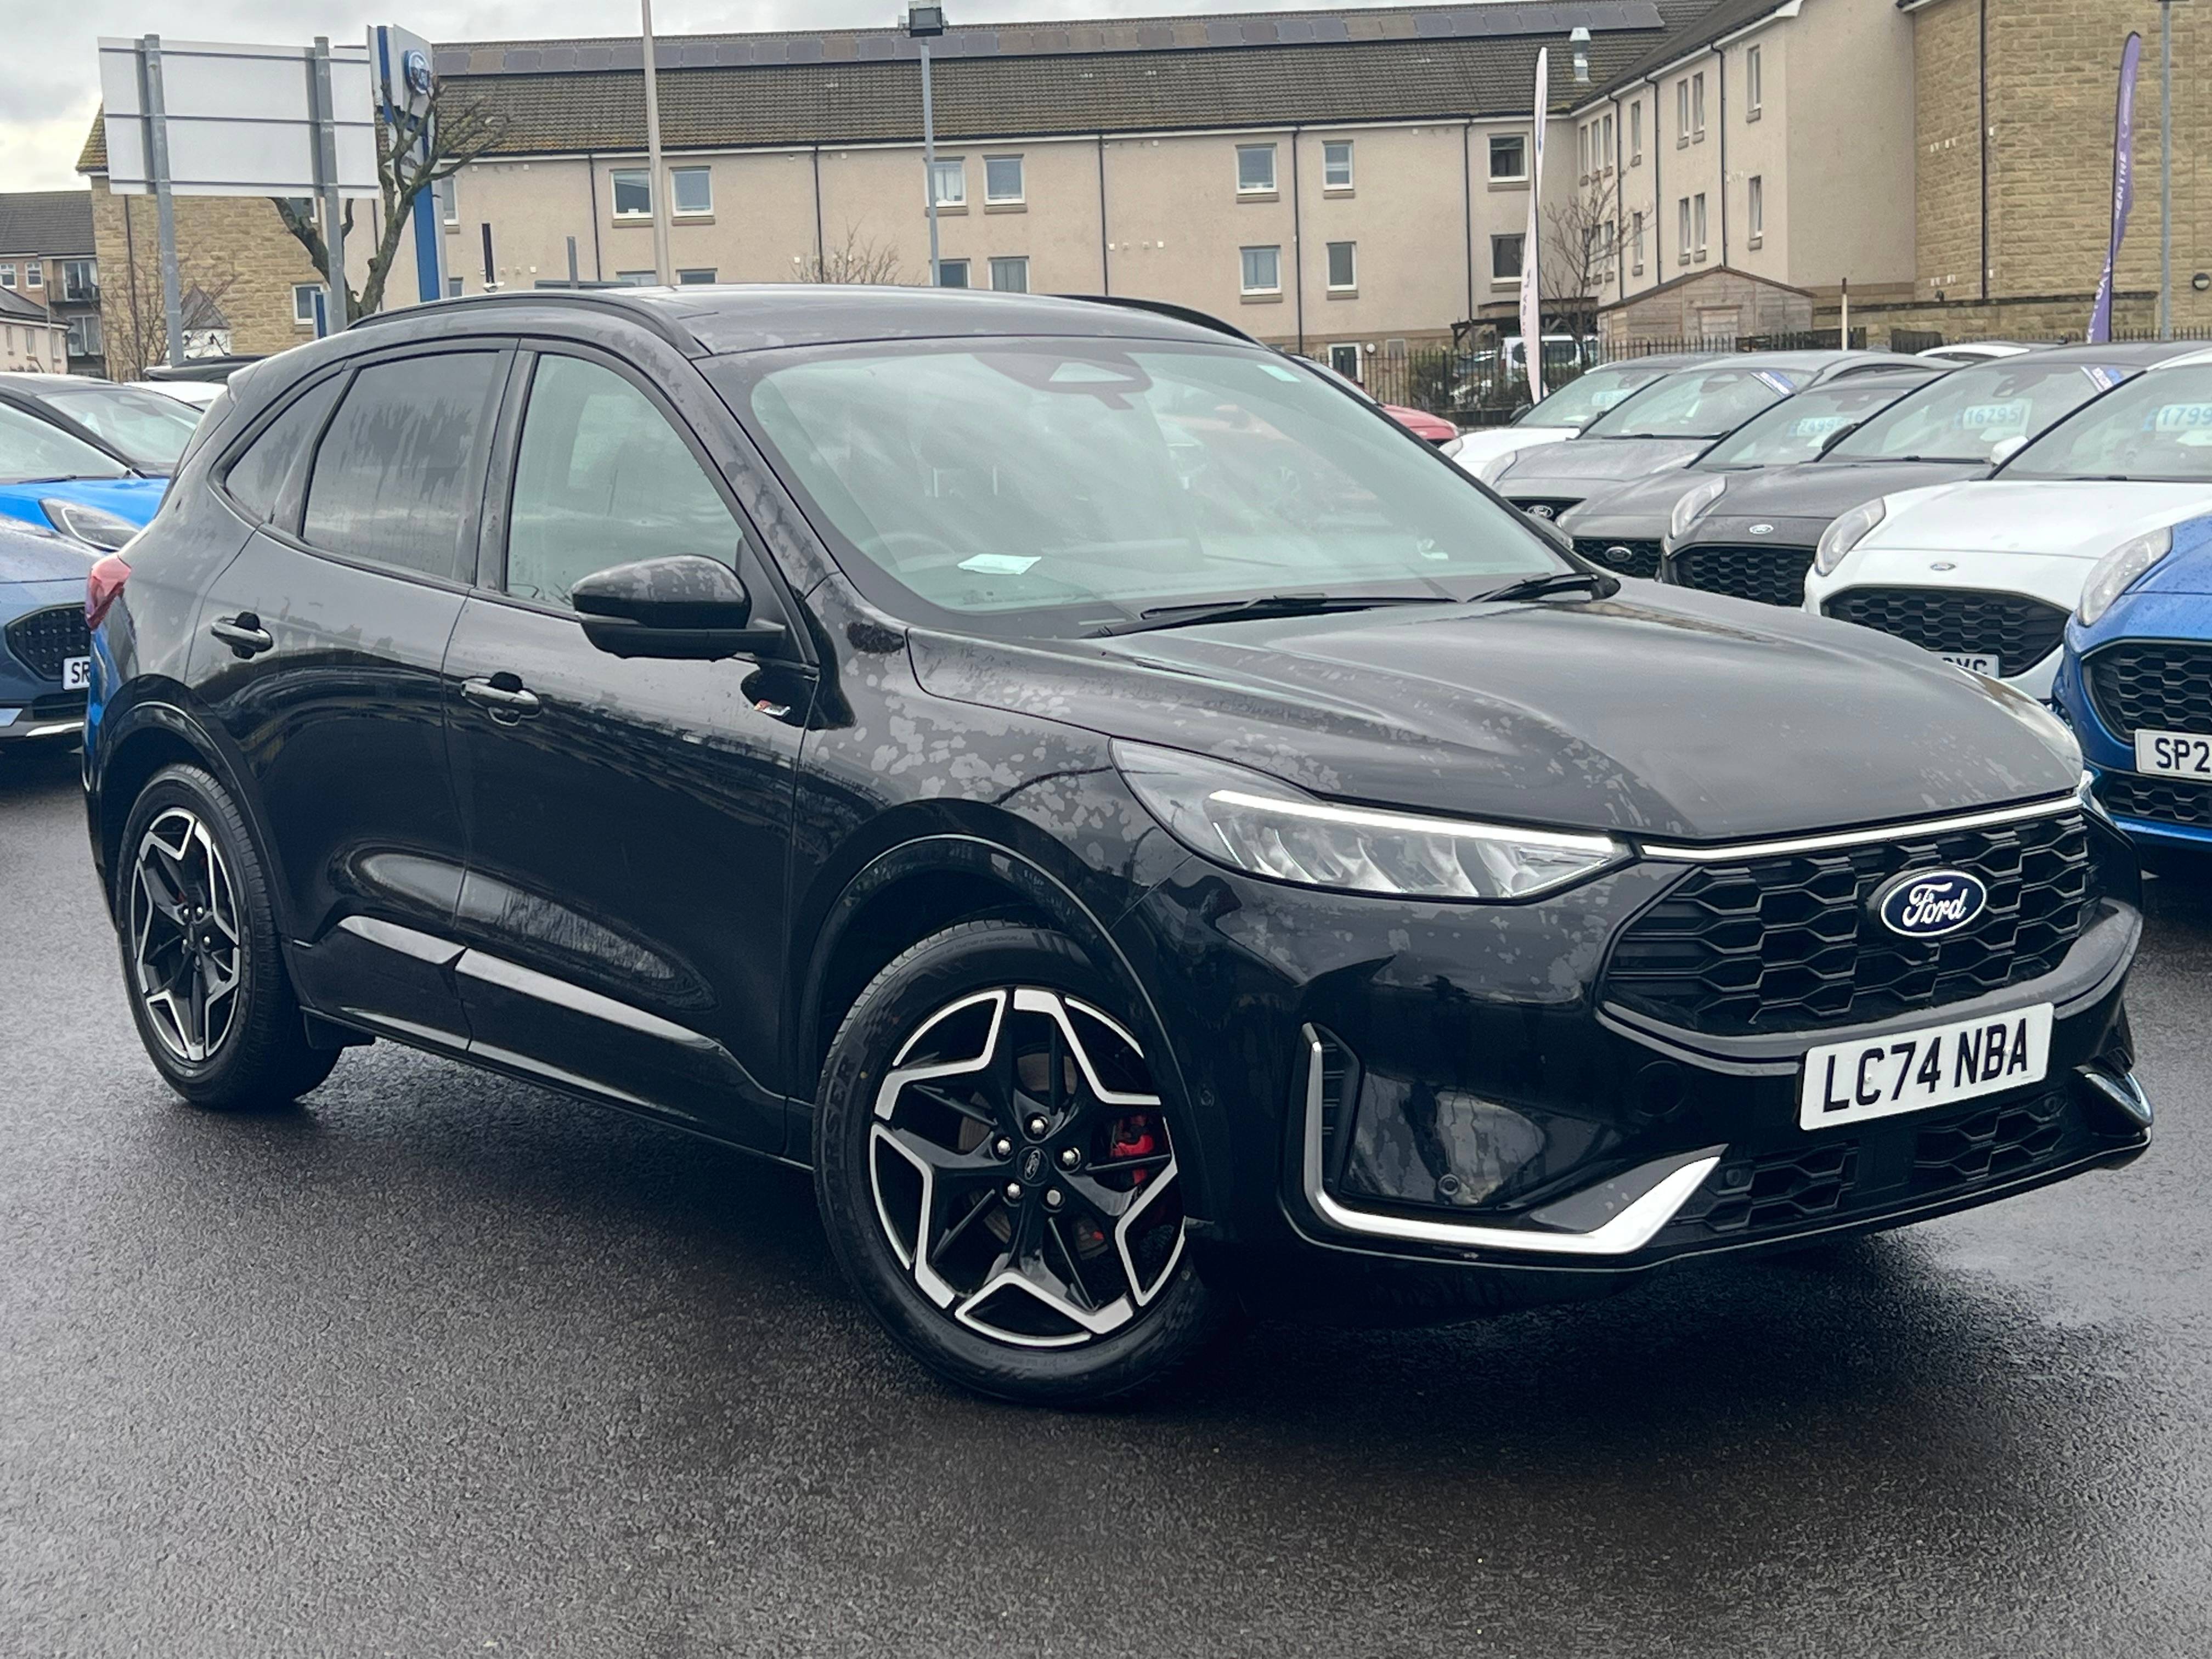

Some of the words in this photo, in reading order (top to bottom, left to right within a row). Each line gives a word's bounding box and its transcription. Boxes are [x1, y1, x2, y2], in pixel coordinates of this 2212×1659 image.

[2154, 737, 2211, 773] SP2
[1902, 882, 1968, 927] Ford
[1822, 1036, 1942, 1113] LC74
[1954, 1018, 2028, 1088] NBA
